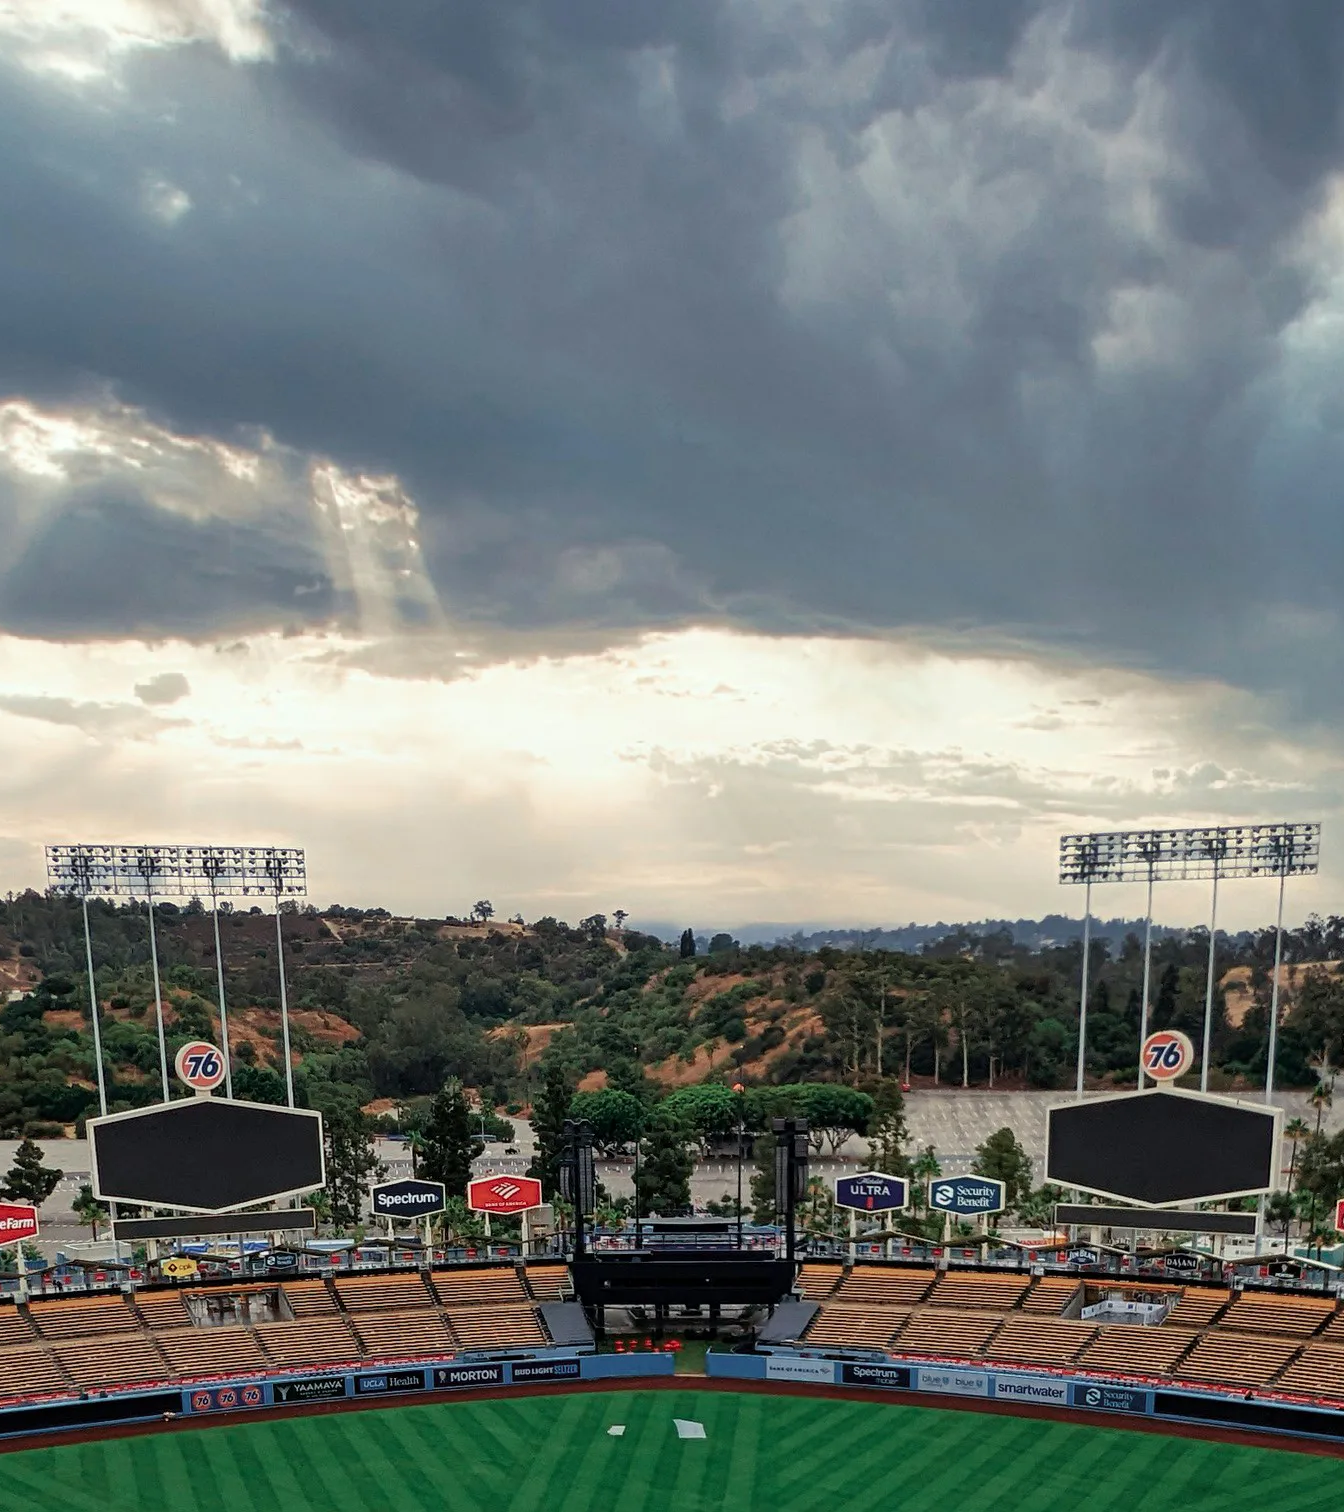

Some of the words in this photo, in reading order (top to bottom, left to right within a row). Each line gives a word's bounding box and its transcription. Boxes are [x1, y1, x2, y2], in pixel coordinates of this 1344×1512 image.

[1149, 1041, 1182, 1069] 76
[187, 1051, 221, 1079] 76
[851, 1185, 891, 1196] ULTRA
[957, 1185, 996, 1197] Security
[378, 1192, 436, 1208] Spectrum
[957, 1197, 990, 1207] Benefit
[1167, 1258, 1196, 1267] DASANI
[450, 1370, 497, 1382] MORTON
[531, 1367, 554, 1375] LIGHT
[853, 1366, 897, 1379] Spectrum
[363, 1379, 385, 1388] UCLA
[389, 1376, 420, 1387] Health
[922, 1374, 941, 1383] blue
[956, 1377, 974, 1387] blue
[998, 1382, 1064, 1399] smartwater
[1103, 1390, 1134, 1401] Security
[1103, 1399, 1130, 1409] Benefit
